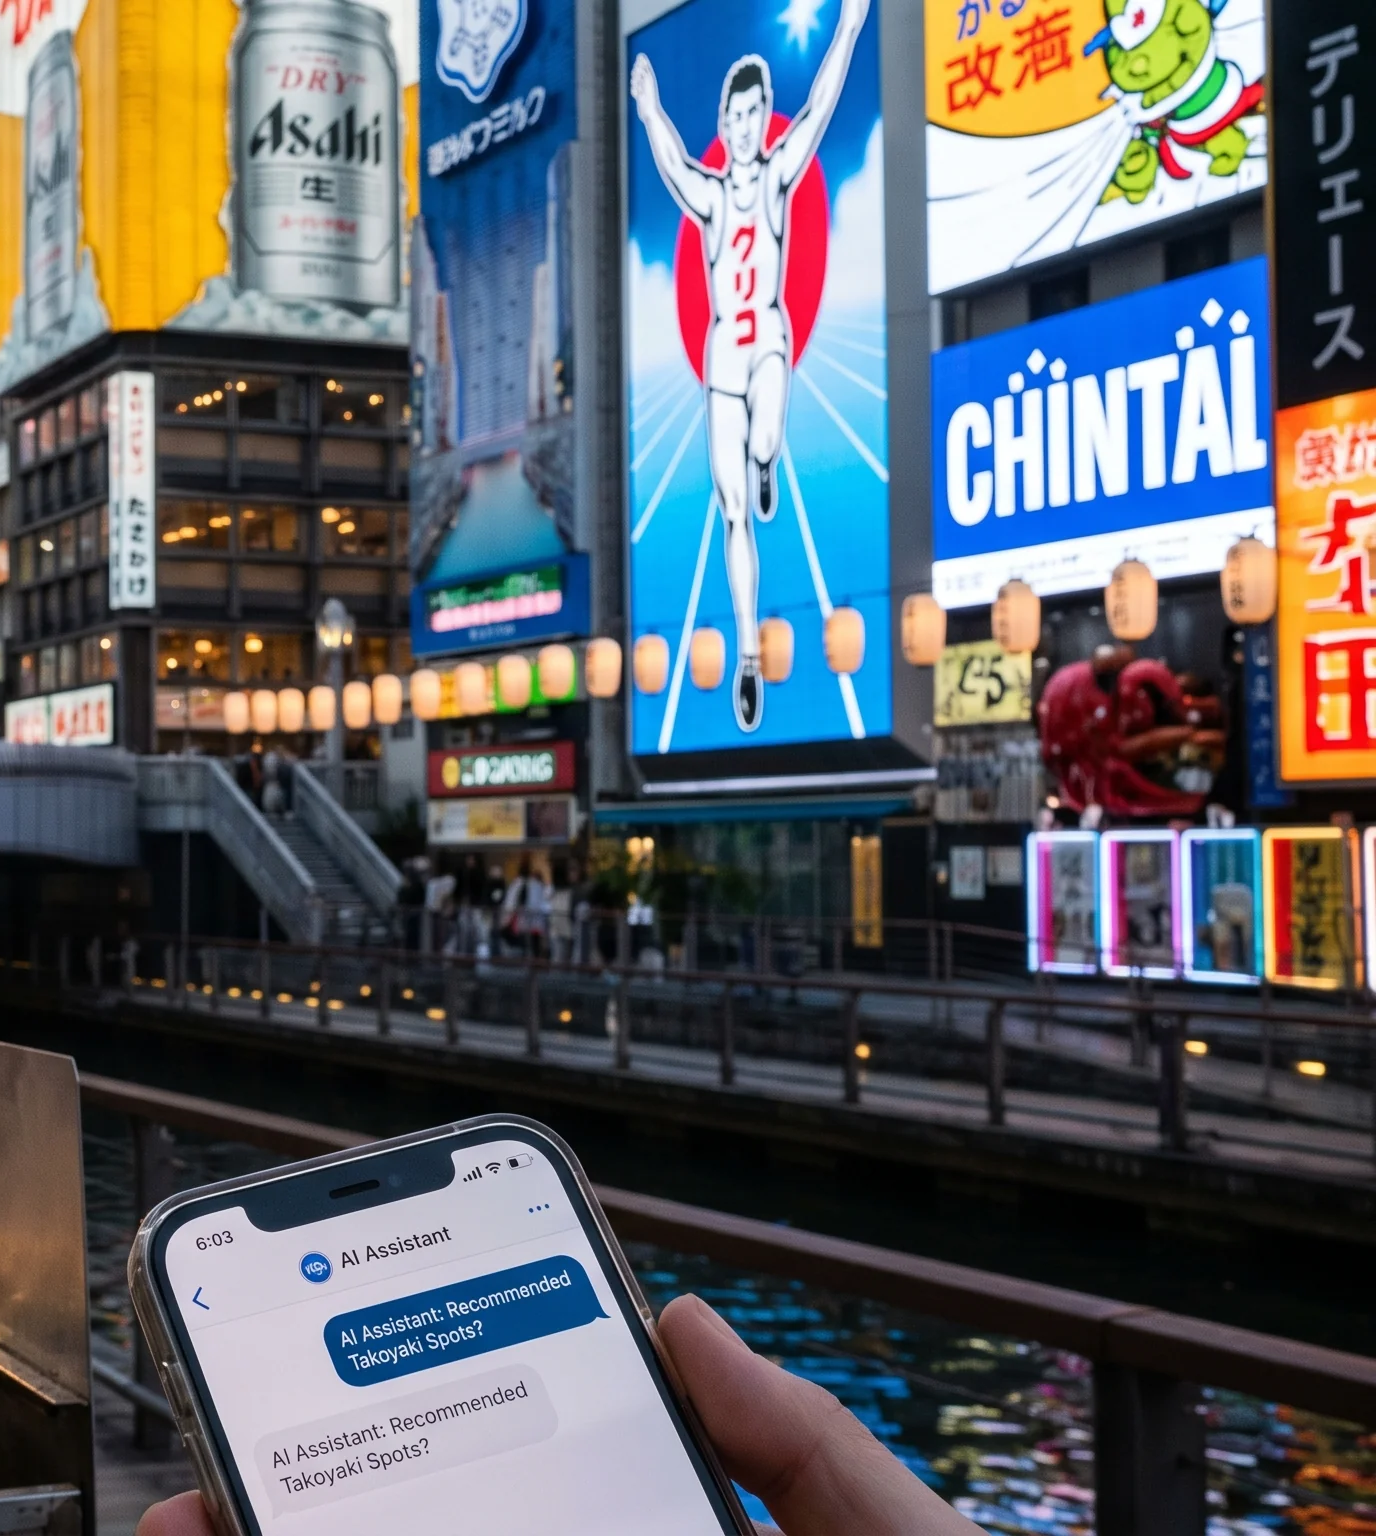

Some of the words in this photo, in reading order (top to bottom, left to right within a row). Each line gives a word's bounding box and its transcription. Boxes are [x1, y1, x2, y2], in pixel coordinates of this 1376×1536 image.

[248, 97, 382, 166] Asahi
[301, 176, 336, 204] 生
[731, 223, 757, 346] グリコ
[195, 1230, 234, 1251] 6:03
[340, 1249, 362, 1269] AI
[365, 1226, 452, 1262] Assistant
[340, 1328, 358, 1348] AI
[362, 1307, 444, 1343] Assistant:
[445, 1269, 572, 1317] Recommended
[347, 1336, 424, 1371] Takoyaki
[426, 1319, 483, 1350] Spots?
[272, 1448, 292, 1469] AI
[296, 1421, 386, 1462] Assistant:
[389, 1380, 529, 1434] Recommended
[279, 1456, 364, 1494] Takoyaki
[366, 1437, 430, 1471] Spots?
